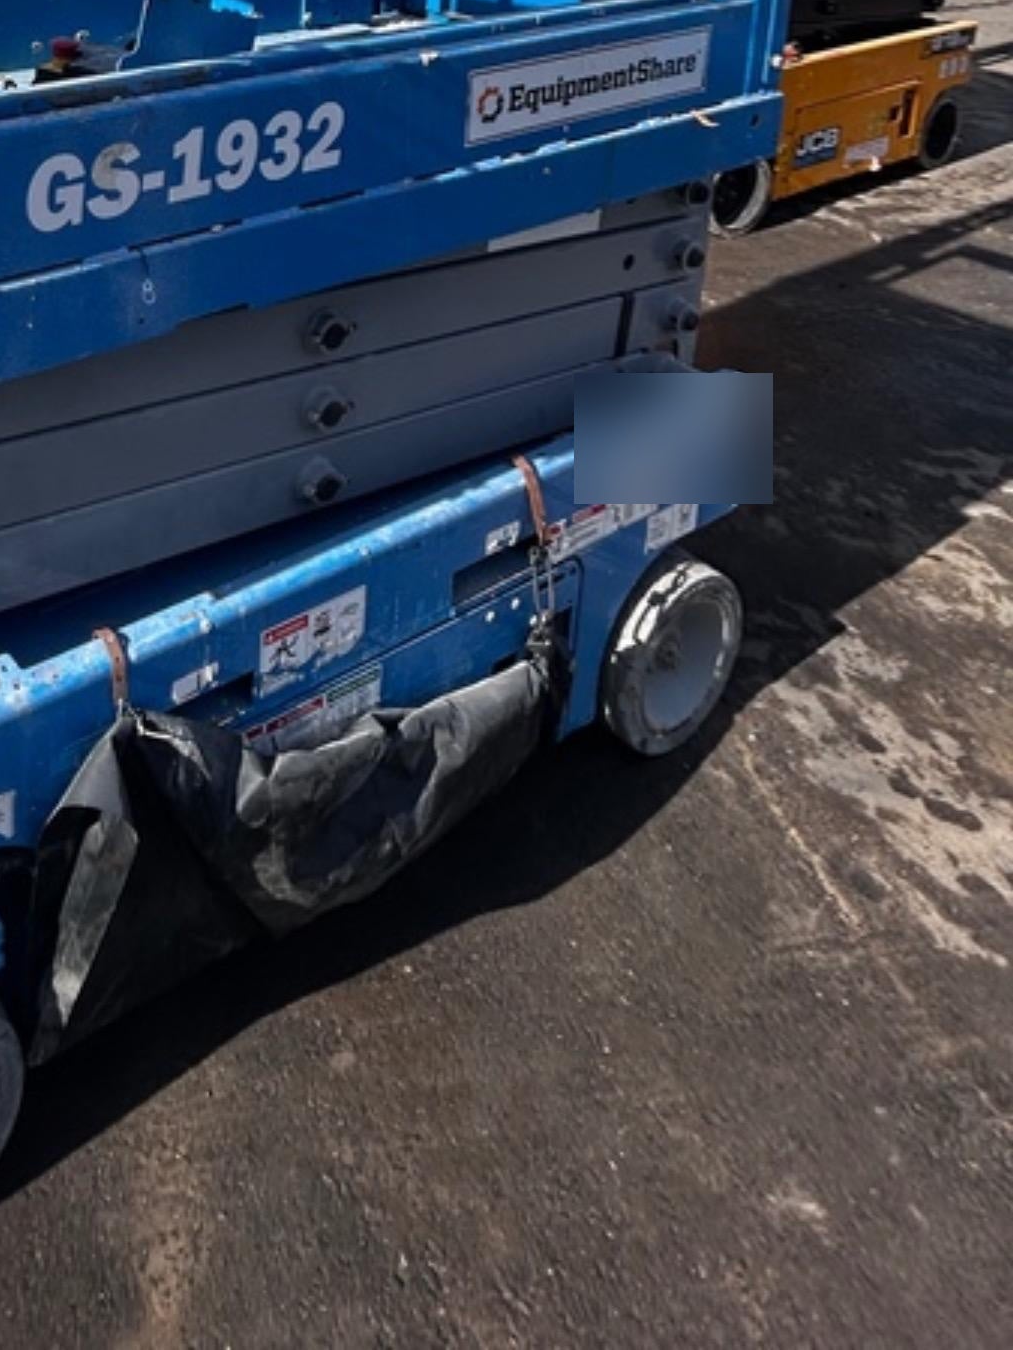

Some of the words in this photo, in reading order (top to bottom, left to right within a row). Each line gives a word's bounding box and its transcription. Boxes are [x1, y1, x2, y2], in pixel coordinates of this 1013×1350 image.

[508, 54, 697, 114] EquipmentShare
[26, 101, 345, 232] GS-1932
[796, 127, 839, 157] JCB
